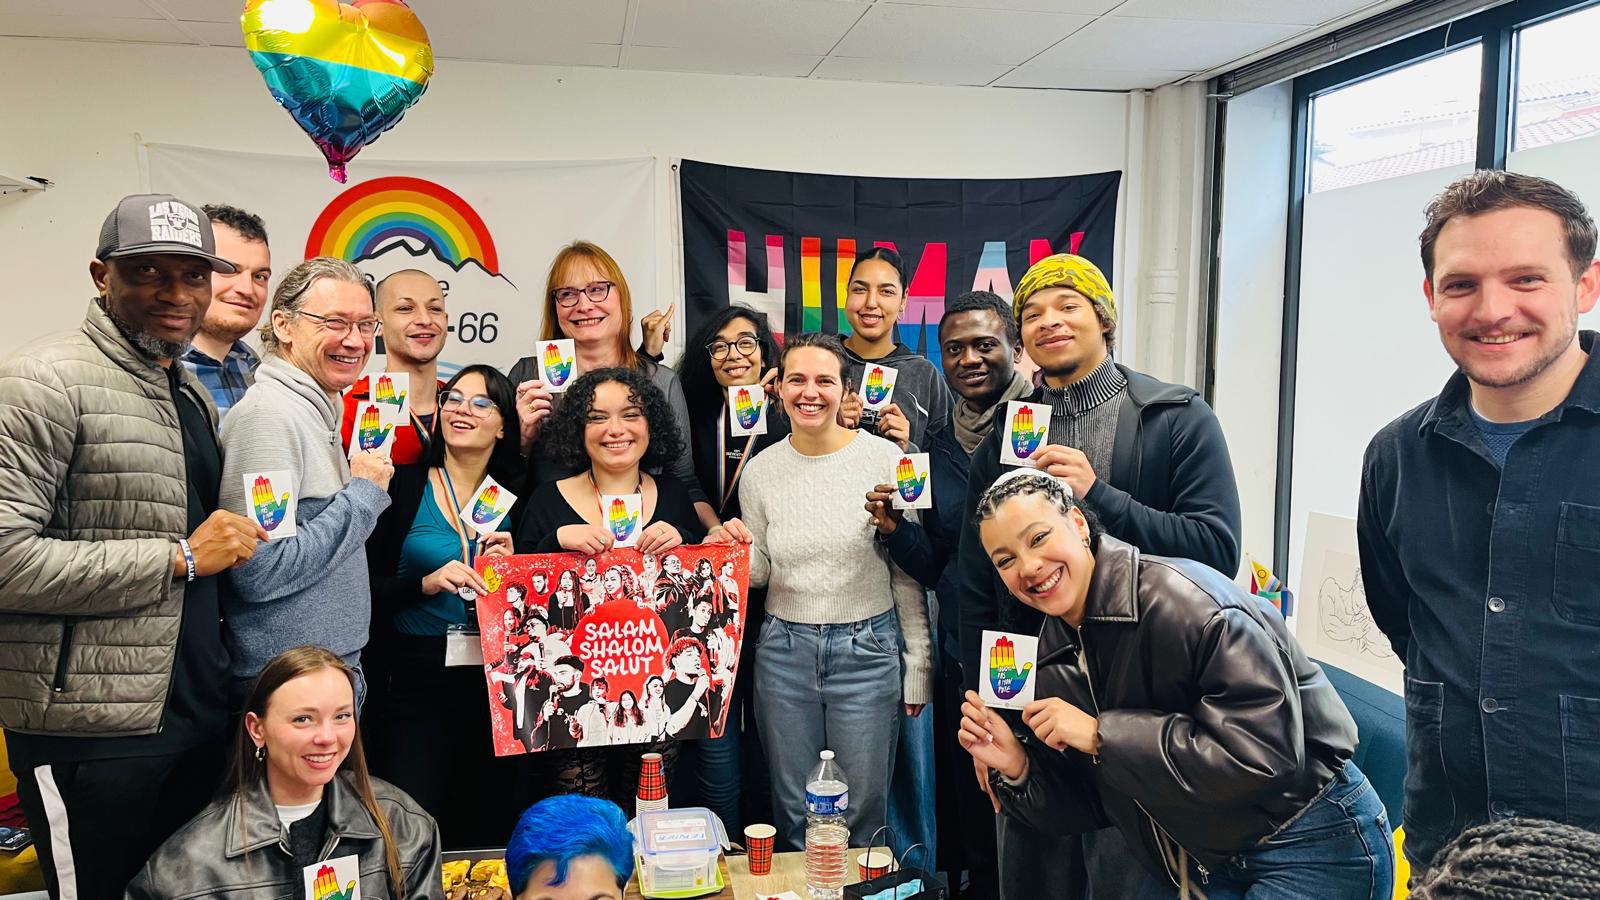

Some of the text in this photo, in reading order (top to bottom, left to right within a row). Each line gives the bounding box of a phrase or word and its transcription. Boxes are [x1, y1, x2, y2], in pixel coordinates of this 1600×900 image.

[149, 201, 199, 226] LAS VEGAS
[151, 225, 203, 248] RAIDERS
[727, 229, 1085, 366] HUMA
[585, 618, 658, 641] SALAM
[579, 636, 664, 660] SHALOM
[590, 656, 654, 678] SALUT
